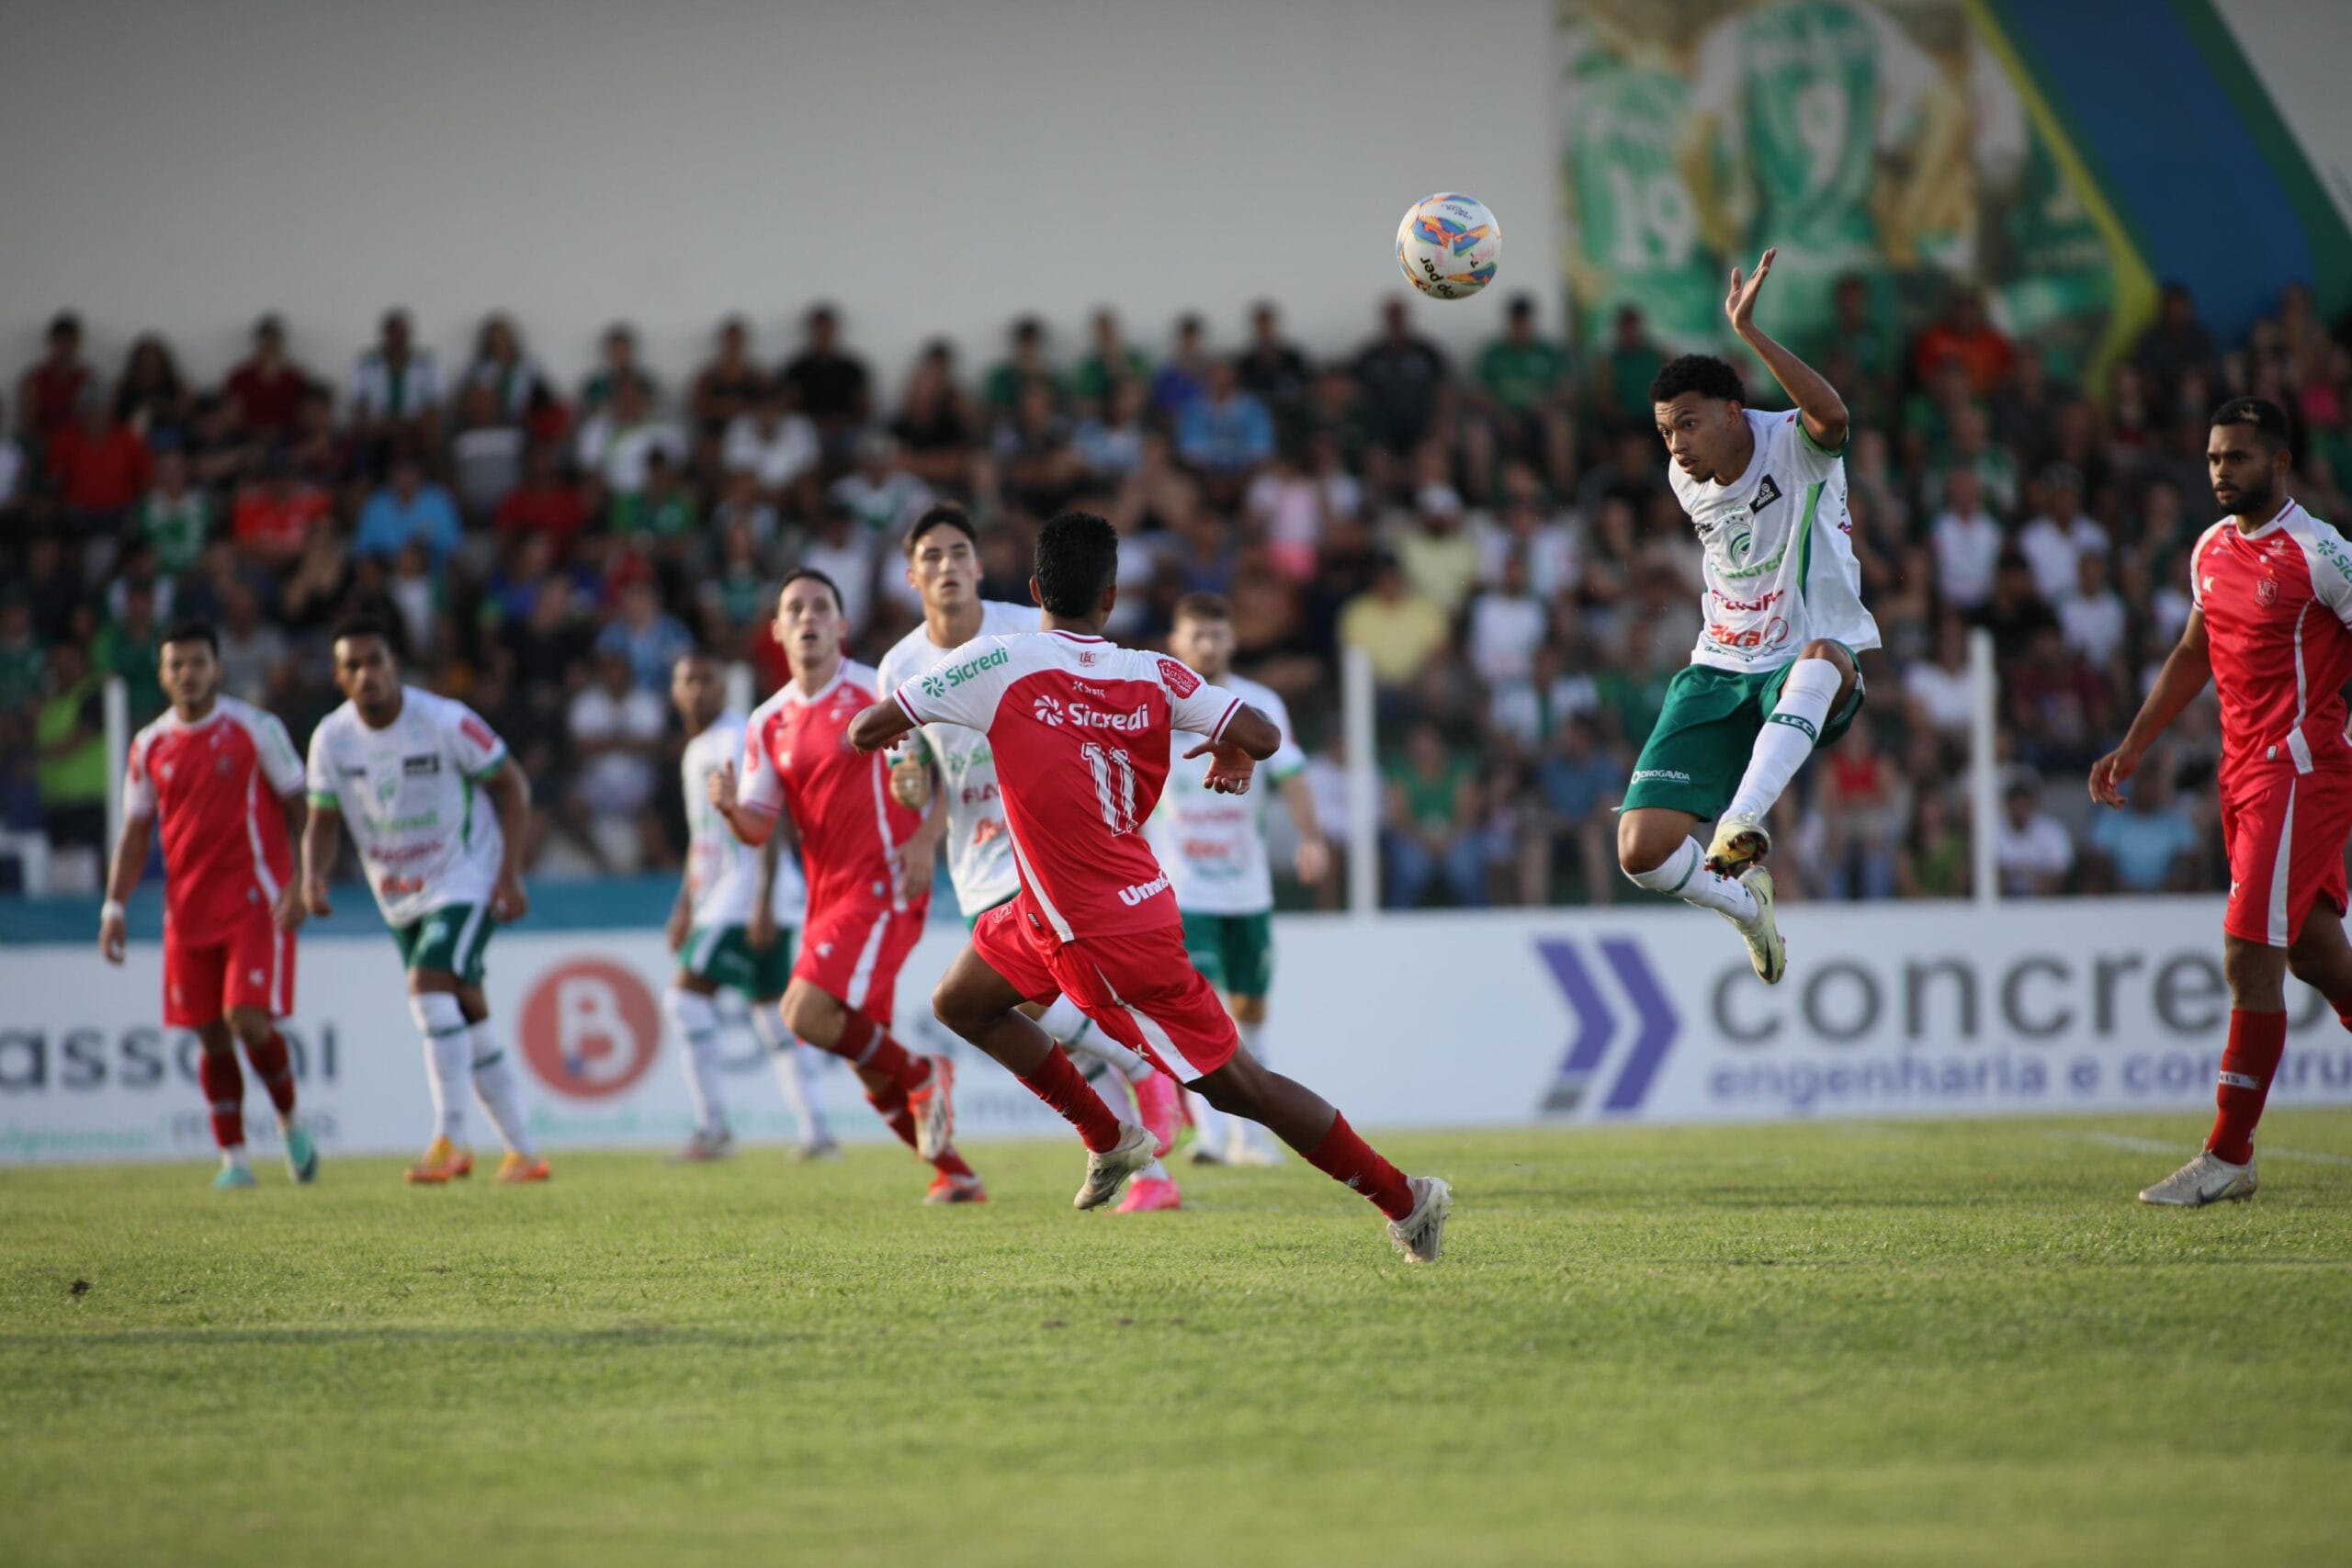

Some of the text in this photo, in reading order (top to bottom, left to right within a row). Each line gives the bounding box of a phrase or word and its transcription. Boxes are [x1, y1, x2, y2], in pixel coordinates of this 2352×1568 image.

[944, 647, 1010, 688] Sicredi
[1068, 703, 1150, 732] Sicredi
[1779, 715, 1815, 736] LEC
[1080, 741, 1139, 838] 11
[1639, 769, 1691, 782] DROGAVIDA
[1709, 1049, 2352, 1108] engenharia e contru
